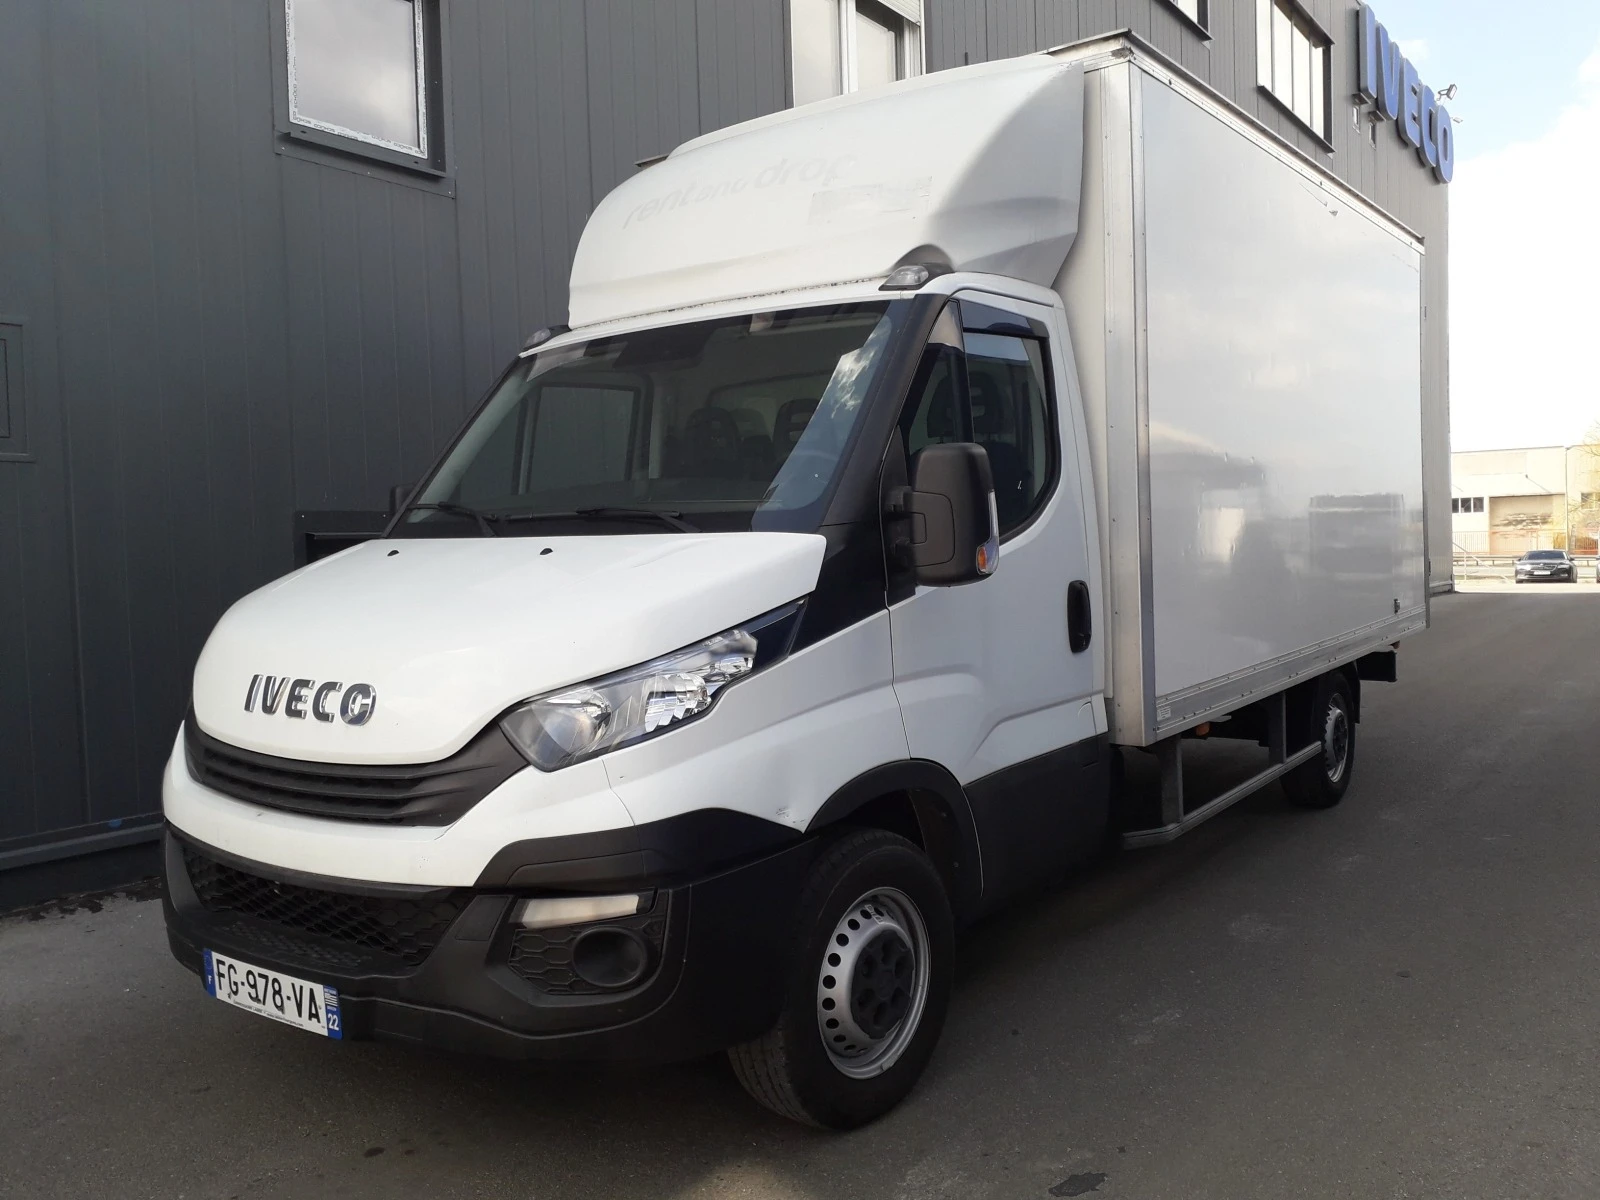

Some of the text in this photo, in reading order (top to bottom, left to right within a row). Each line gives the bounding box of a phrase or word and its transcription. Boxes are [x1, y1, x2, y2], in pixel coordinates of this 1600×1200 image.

[1359, 3, 1454, 184] IVECO
[244, 673, 377, 727] IVECO
[216, 958, 322, 1024] FG-978-VA
[327, 1013, 340, 1031] 22
